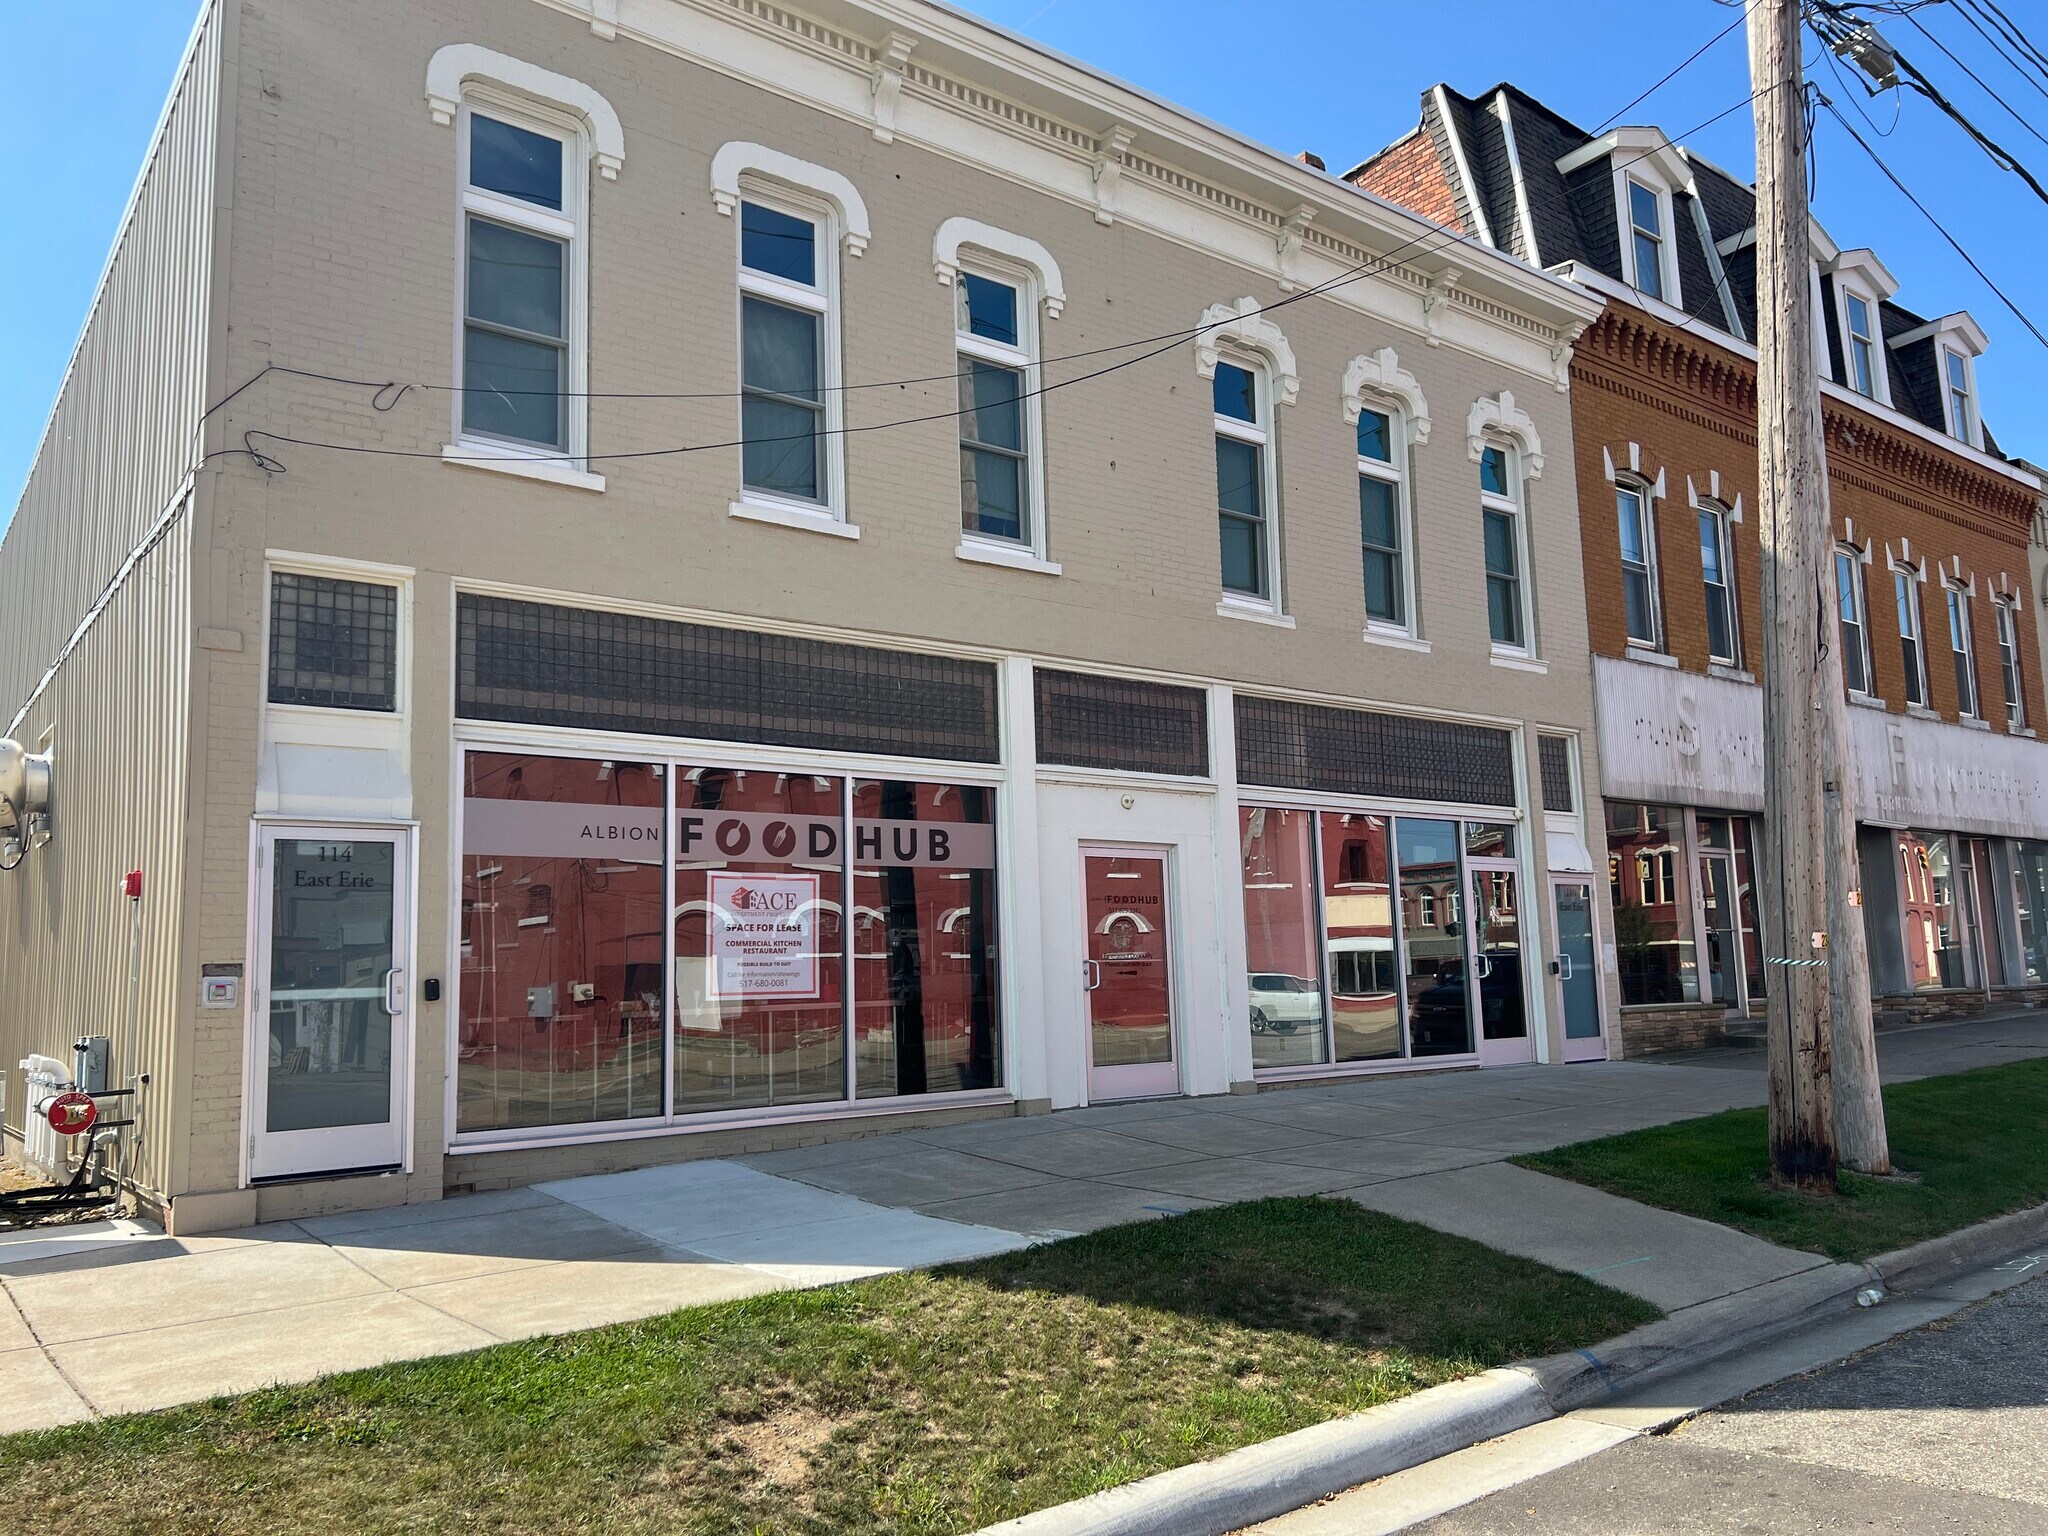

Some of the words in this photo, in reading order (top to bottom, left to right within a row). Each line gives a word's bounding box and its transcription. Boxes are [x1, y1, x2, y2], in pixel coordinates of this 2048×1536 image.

[581, 824, 659, 841] ALBION
[319, 844, 352, 862] 114
[294, 870, 332, 887] East
[338, 870, 375, 887] Erie
[755, 892, 797, 910] ACE
[726, 924, 754, 932] SPACE
[756, 924, 774, 932] FOR
[776, 924, 802, 932] LEASE
[739, 979, 788, 987] 517-680-0081
[55, 1094, 72, 1105] AUTO
